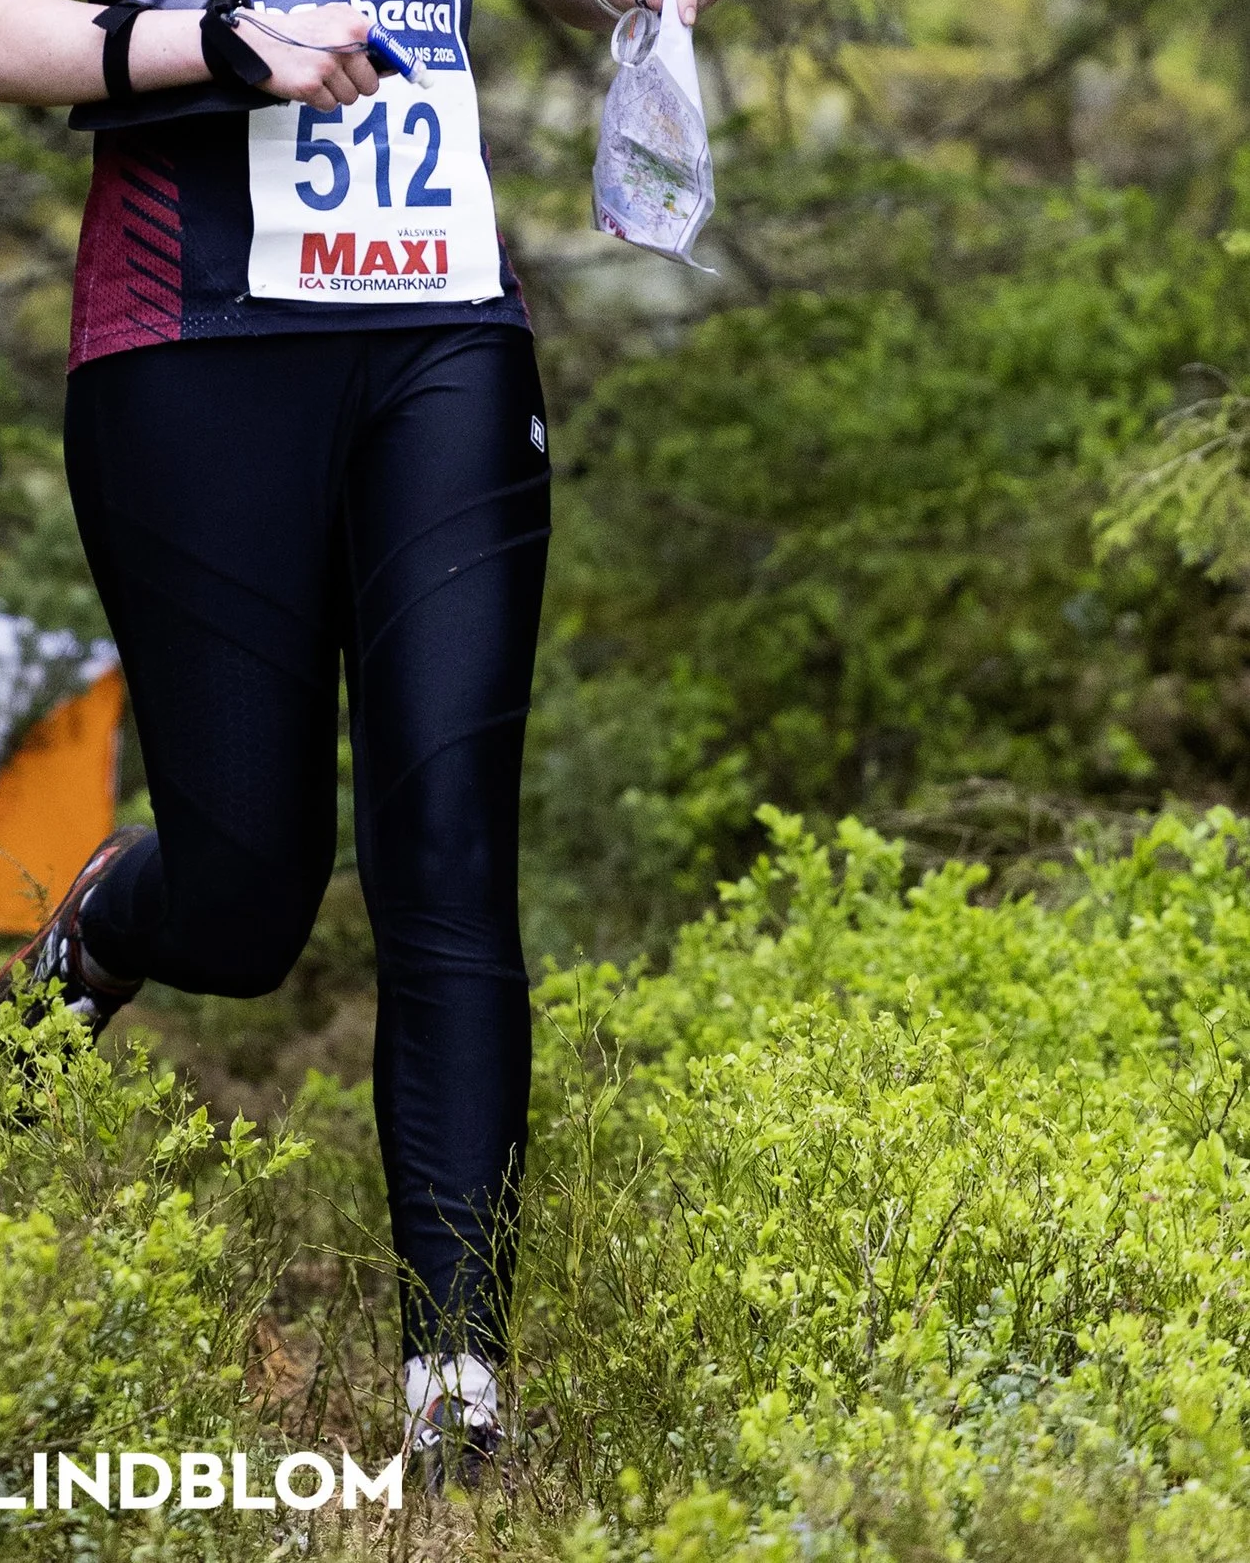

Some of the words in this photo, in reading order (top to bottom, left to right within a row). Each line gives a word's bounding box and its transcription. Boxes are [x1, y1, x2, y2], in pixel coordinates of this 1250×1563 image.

[433, 47, 456, 63] 2025
[294, 101, 452, 211] 512
[300, 232, 449, 276] MAXI
[299, 277, 325, 289] ICA
[330, 277, 447, 291] STORMARKNAD
